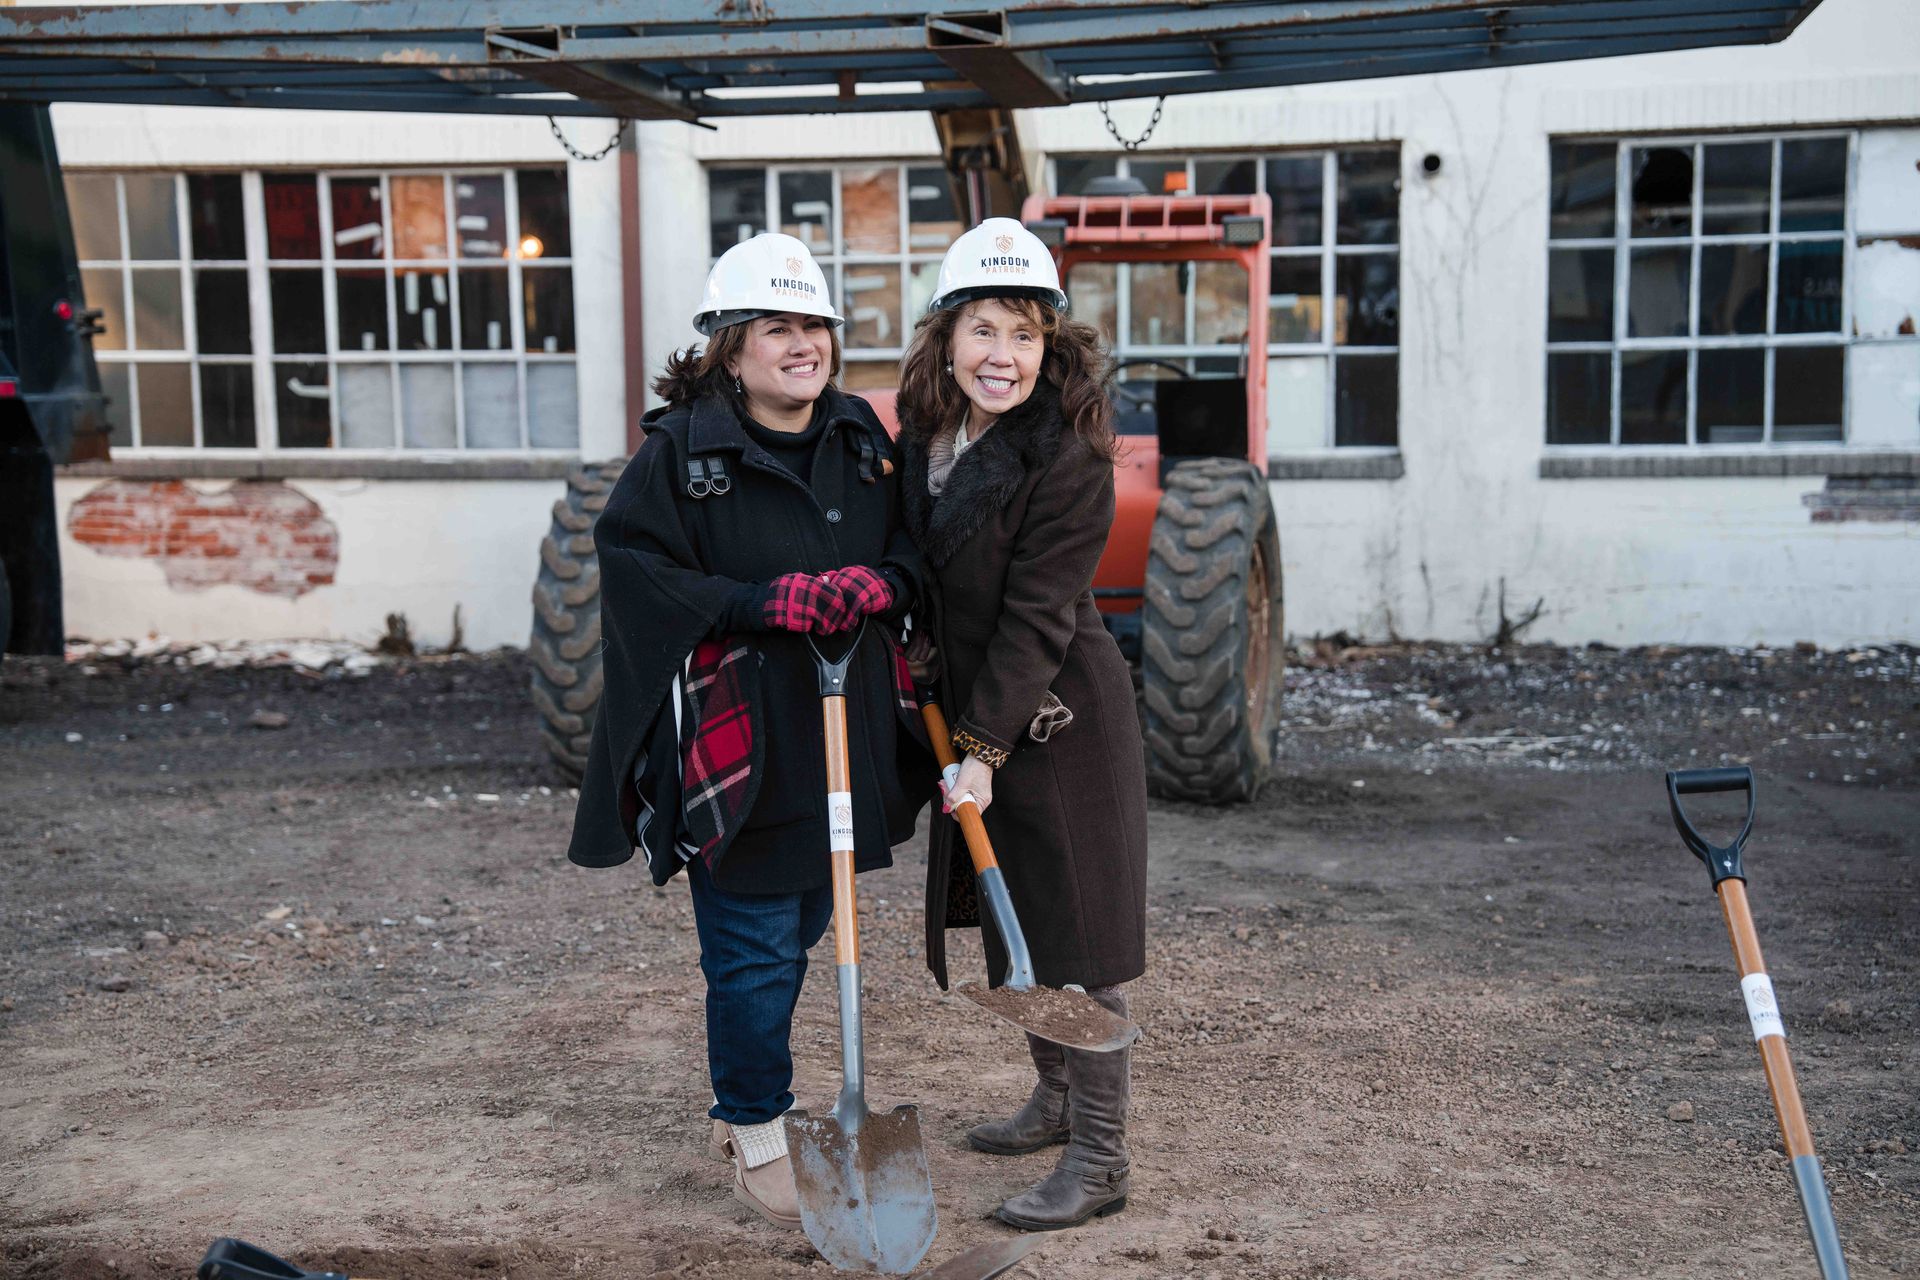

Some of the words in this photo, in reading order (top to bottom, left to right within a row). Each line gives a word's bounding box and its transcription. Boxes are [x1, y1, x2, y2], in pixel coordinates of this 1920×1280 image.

[981, 256, 1030, 268] KINGDOM
[985, 266, 1026, 275] PATRONS
[771, 278, 817, 296] KINGDOM
[775, 287, 814, 301] PATRONS
